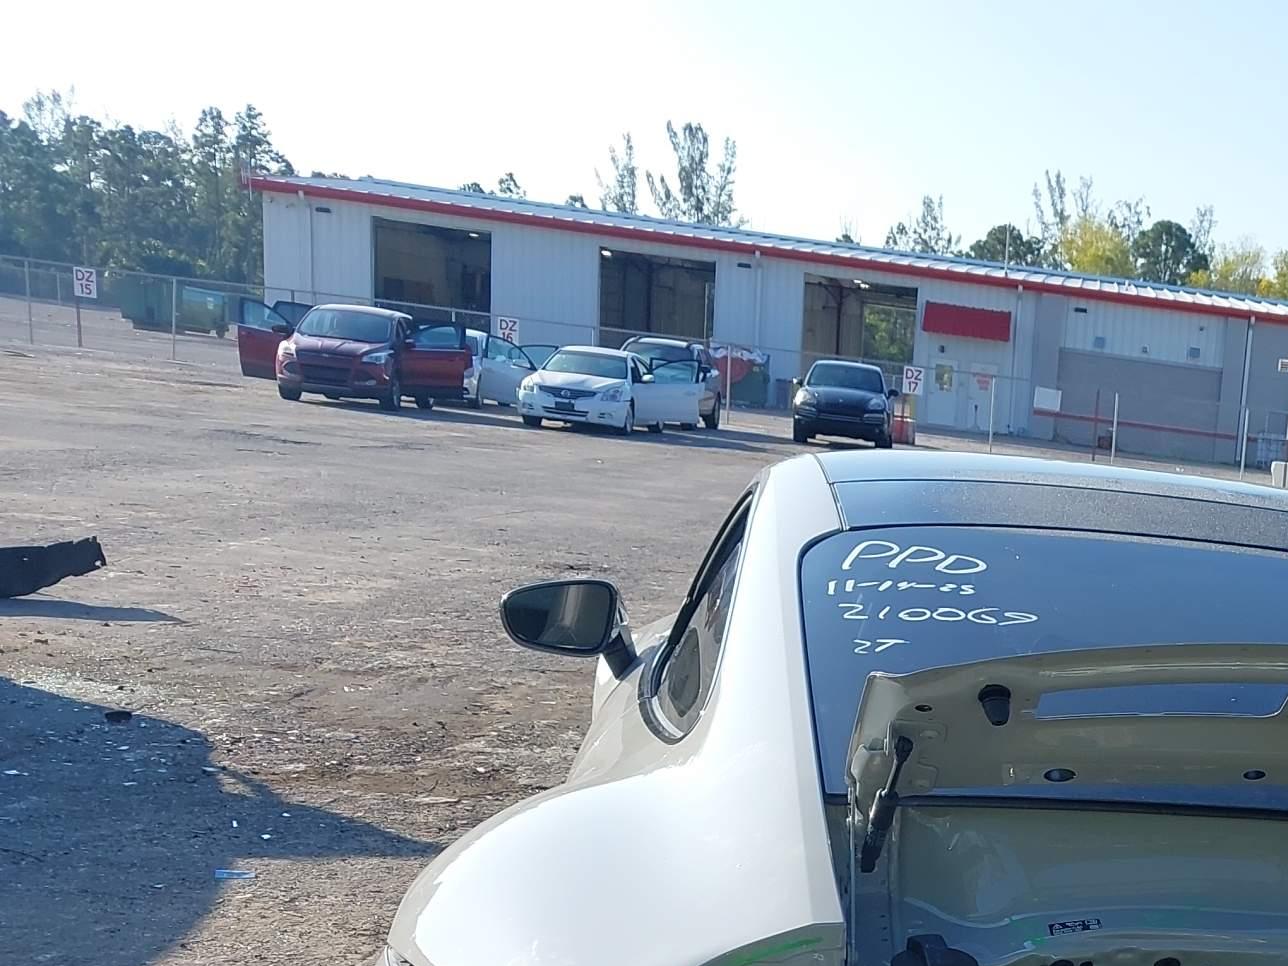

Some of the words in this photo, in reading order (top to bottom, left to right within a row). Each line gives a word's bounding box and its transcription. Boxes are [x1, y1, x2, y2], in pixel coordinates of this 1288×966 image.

[75, 270, 95, 283] DZ
[79, 283, 92, 295] 15
[500, 319, 518, 332] DZ
[502, 331, 513, 343] 16
[905, 368, 923, 381] DZ
[907, 381, 919, 393] 17
[842, 541, 987, 574] PPD
